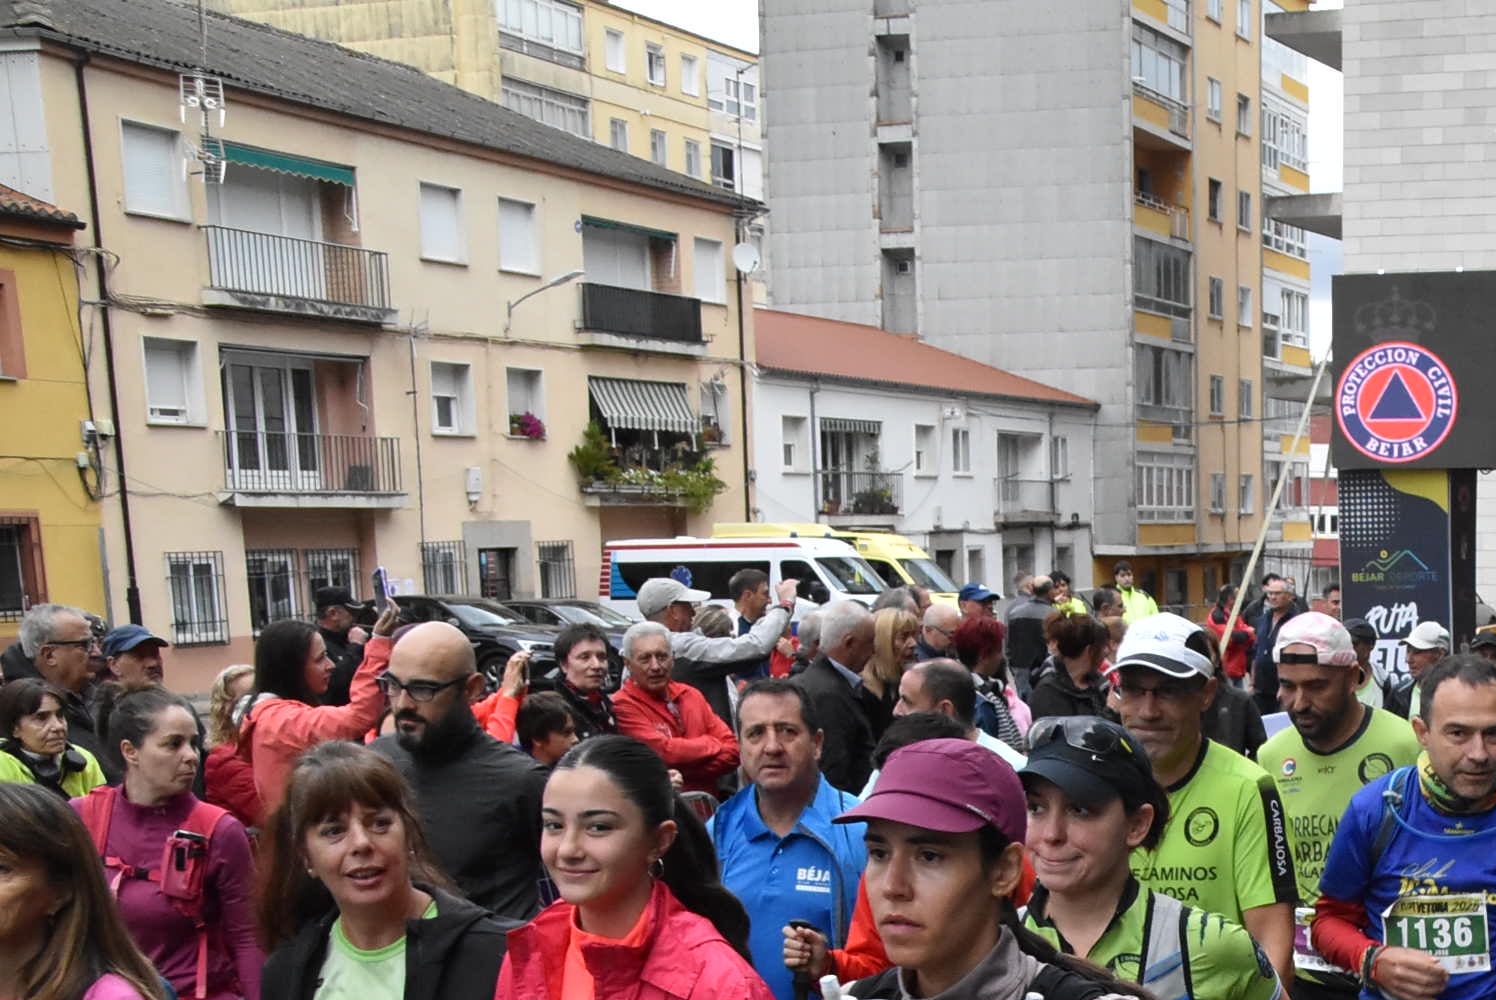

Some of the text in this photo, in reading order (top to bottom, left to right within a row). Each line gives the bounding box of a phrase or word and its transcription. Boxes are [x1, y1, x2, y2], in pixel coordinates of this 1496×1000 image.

[1342, 348, 1452, 418] PROTECCION CIVIL
[1365, 436, 1428, 458] BEJAR
[1364, 601, 1419, 638] RUTA
[1270, 799, 1287, 878] CARBAJOSA
[796, 865, 831, 882] BÉJA
[1396, 916, 1473, 949] 1136
